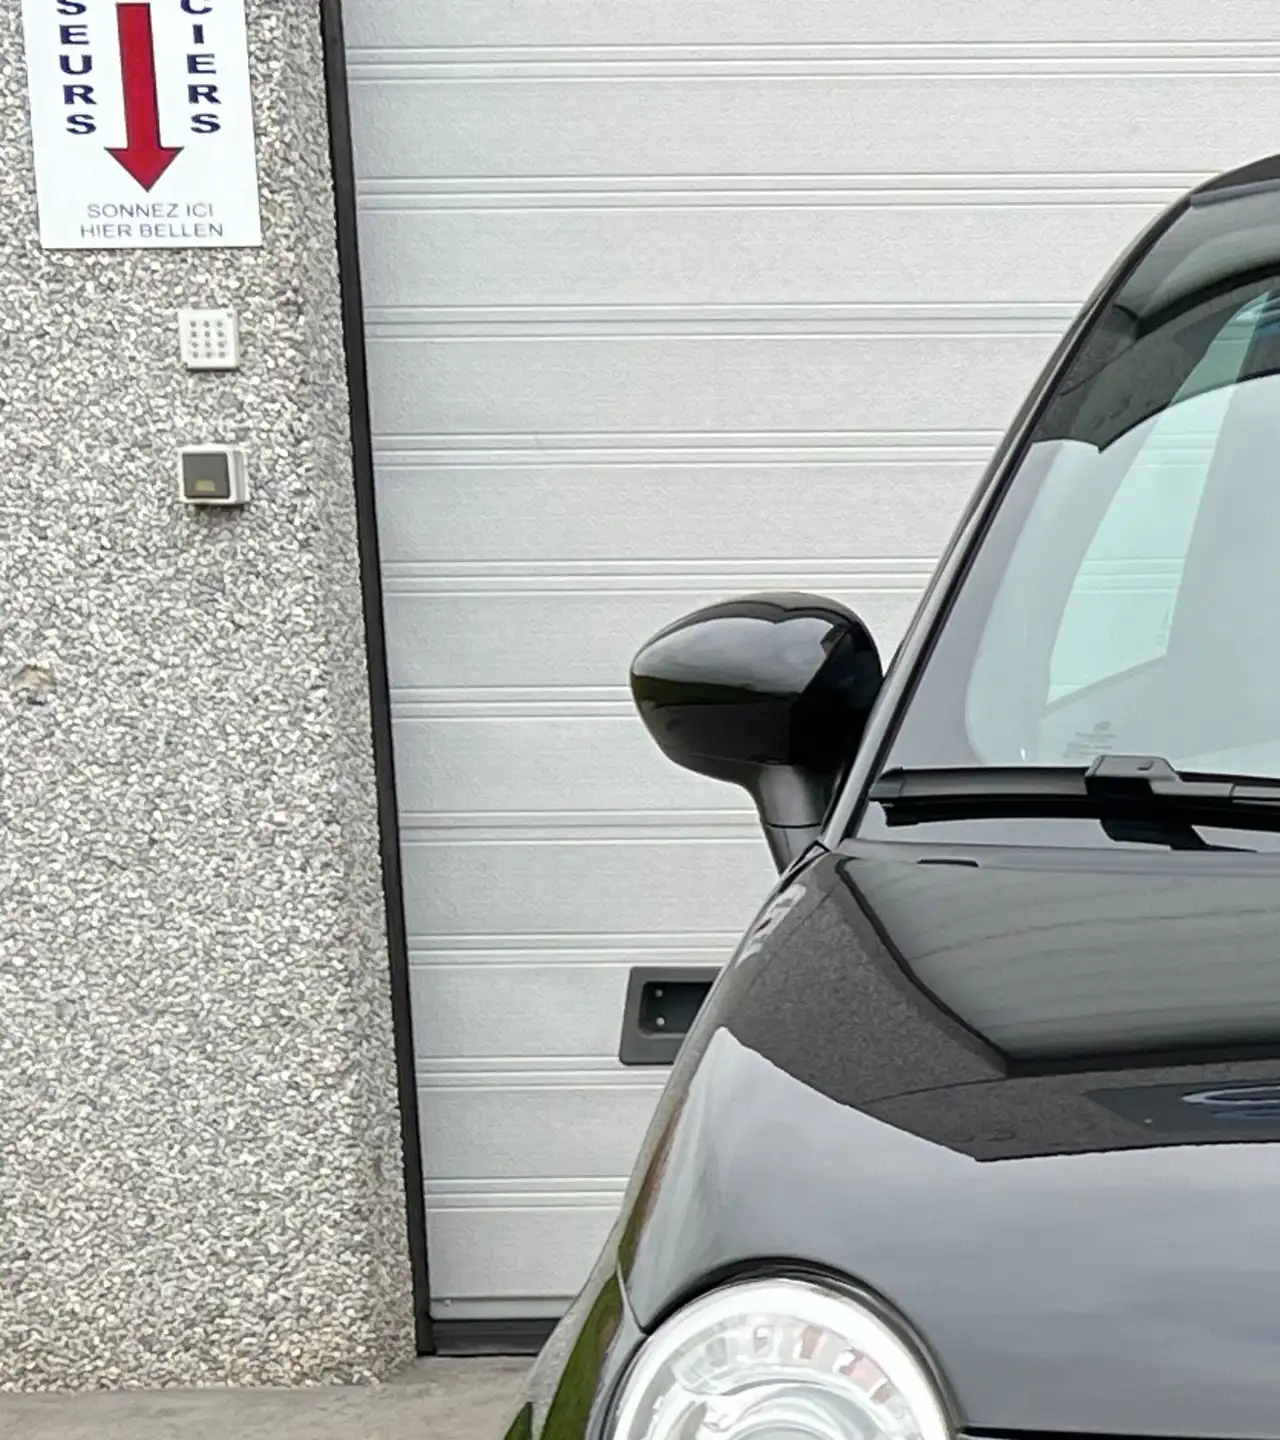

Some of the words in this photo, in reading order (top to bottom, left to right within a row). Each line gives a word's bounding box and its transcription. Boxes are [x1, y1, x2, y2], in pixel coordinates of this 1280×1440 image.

[86, 203, 179, 219] SONNEZ
[186, 202, 214, 218] ICI
[80, 223, 132, 239] HIER
[139, 222, 223, 238] BELLEN
